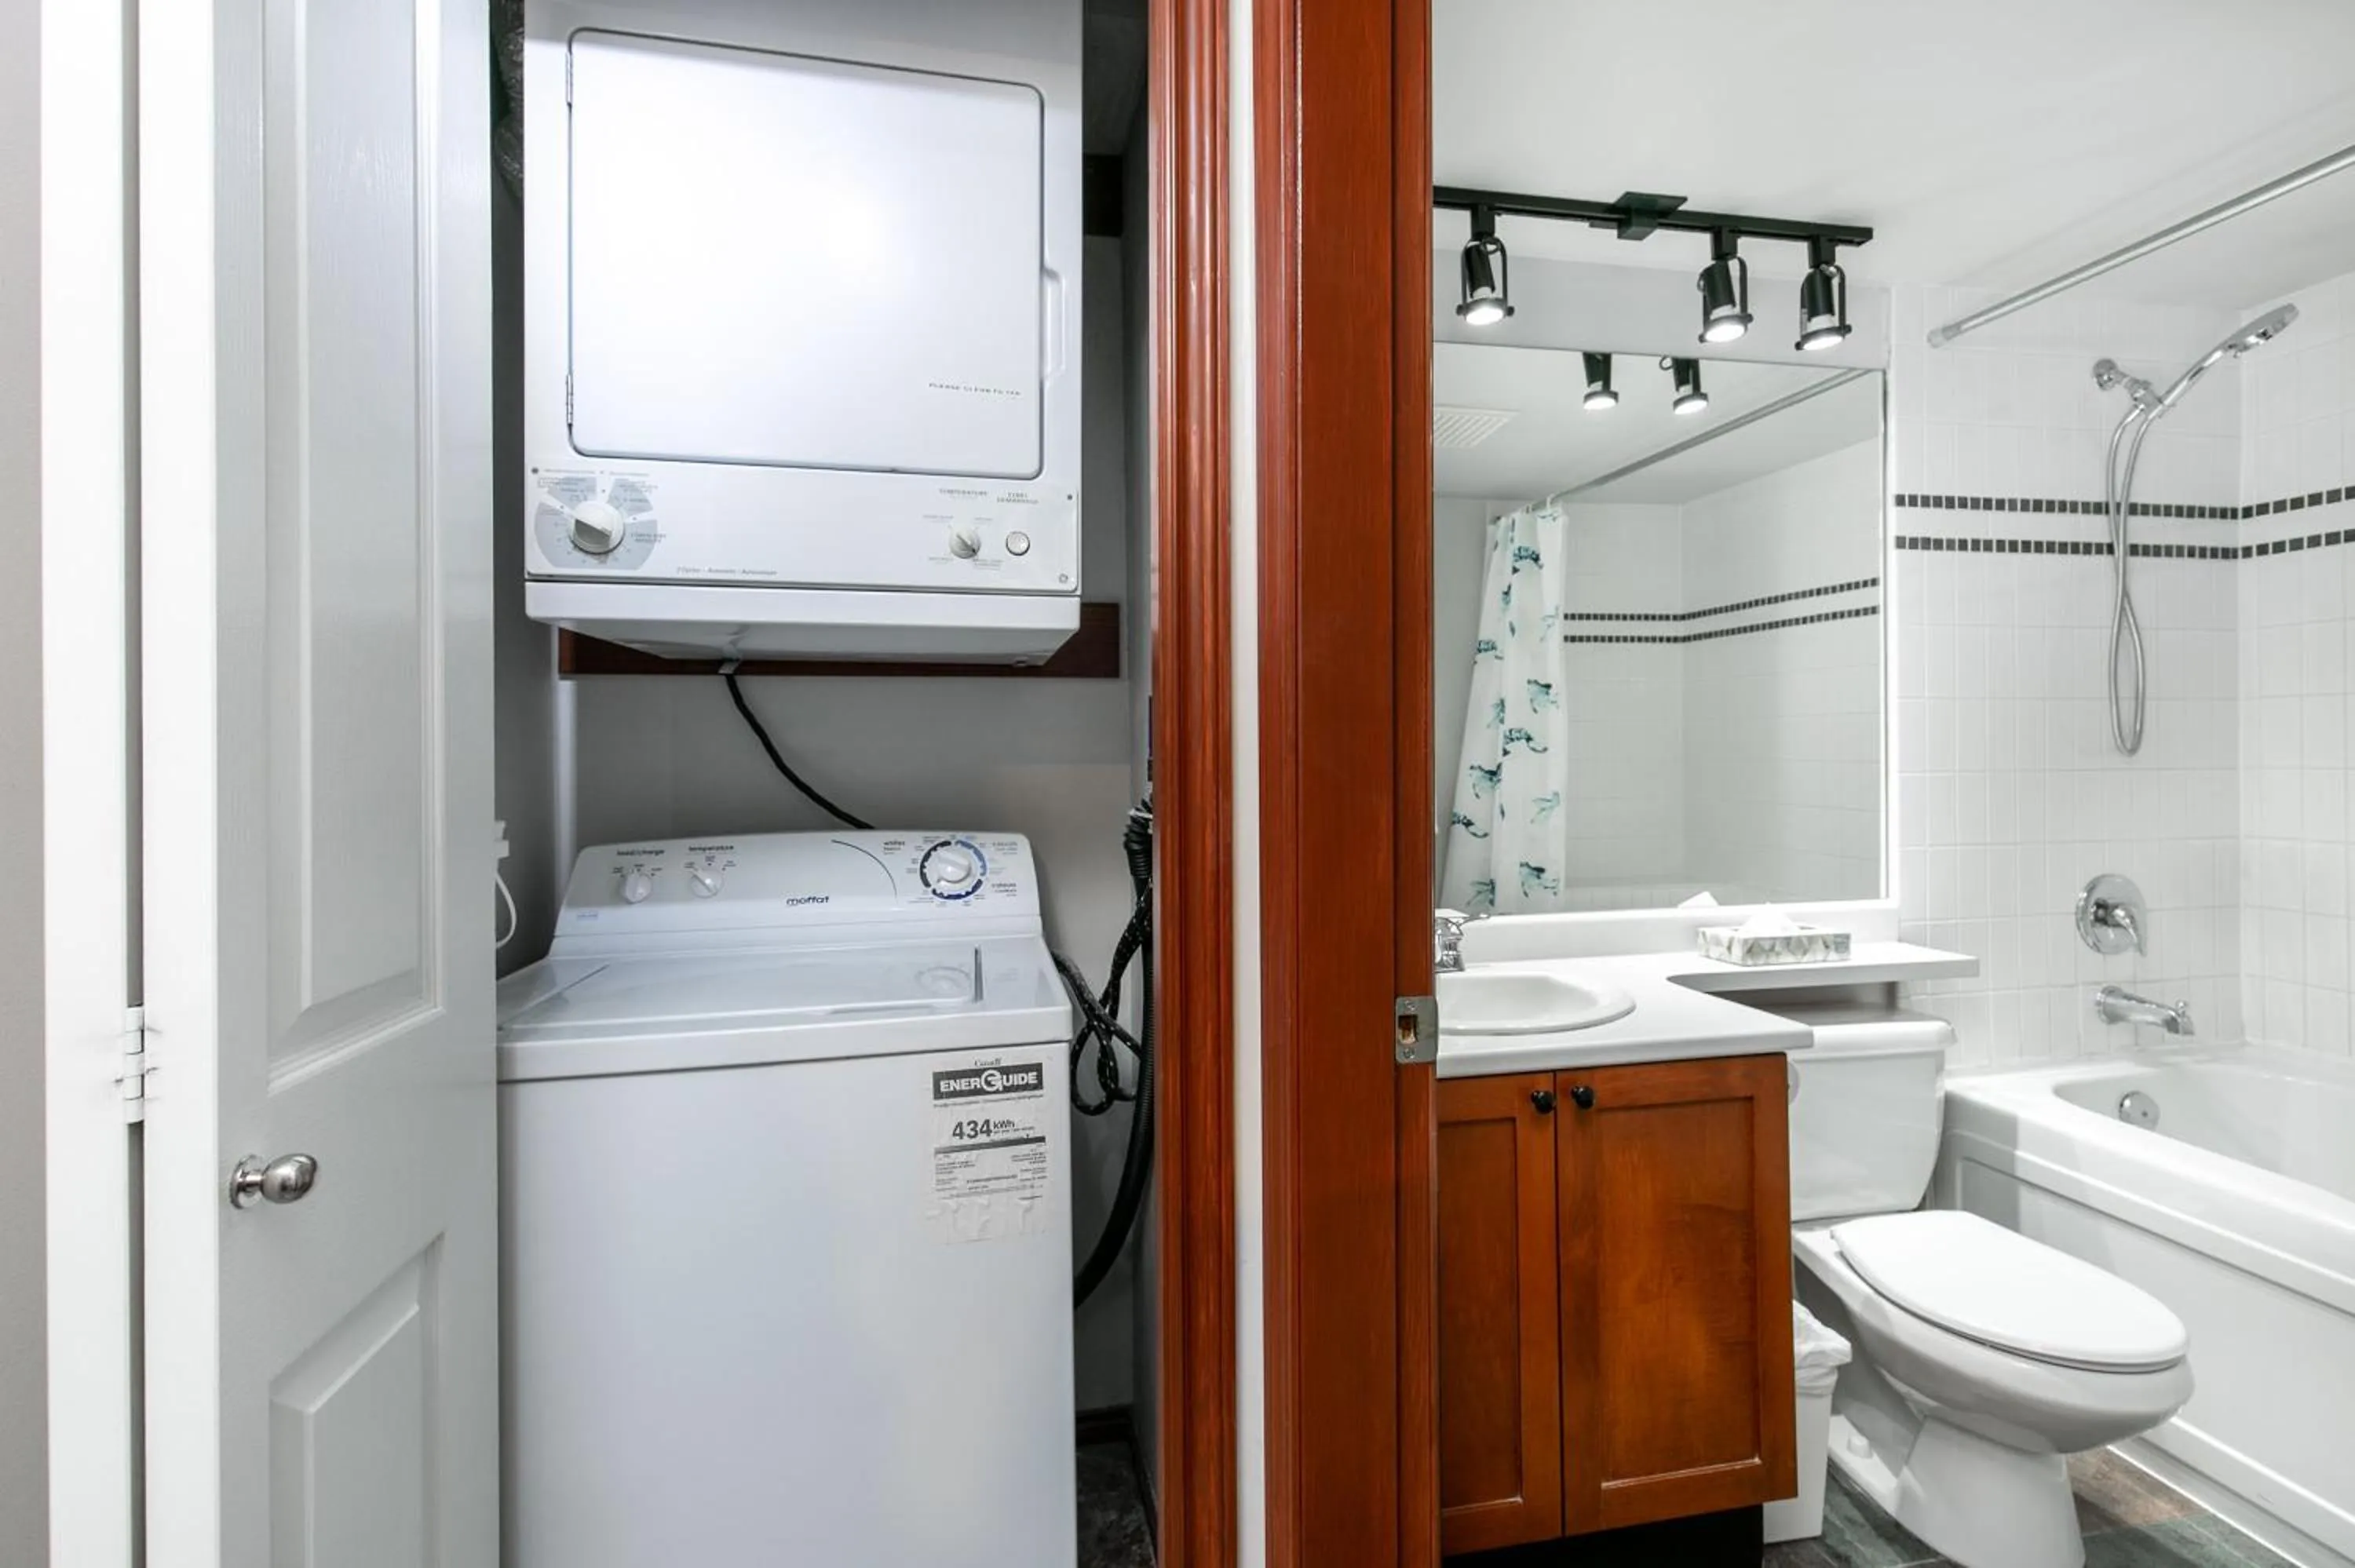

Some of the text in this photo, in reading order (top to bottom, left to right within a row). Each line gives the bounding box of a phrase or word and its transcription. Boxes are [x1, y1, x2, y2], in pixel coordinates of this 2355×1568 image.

[786, 895, 830, 906] moffat
[951, 1118, 993, 1140] 434
[993, 1119, 1015, 1130] kWh
